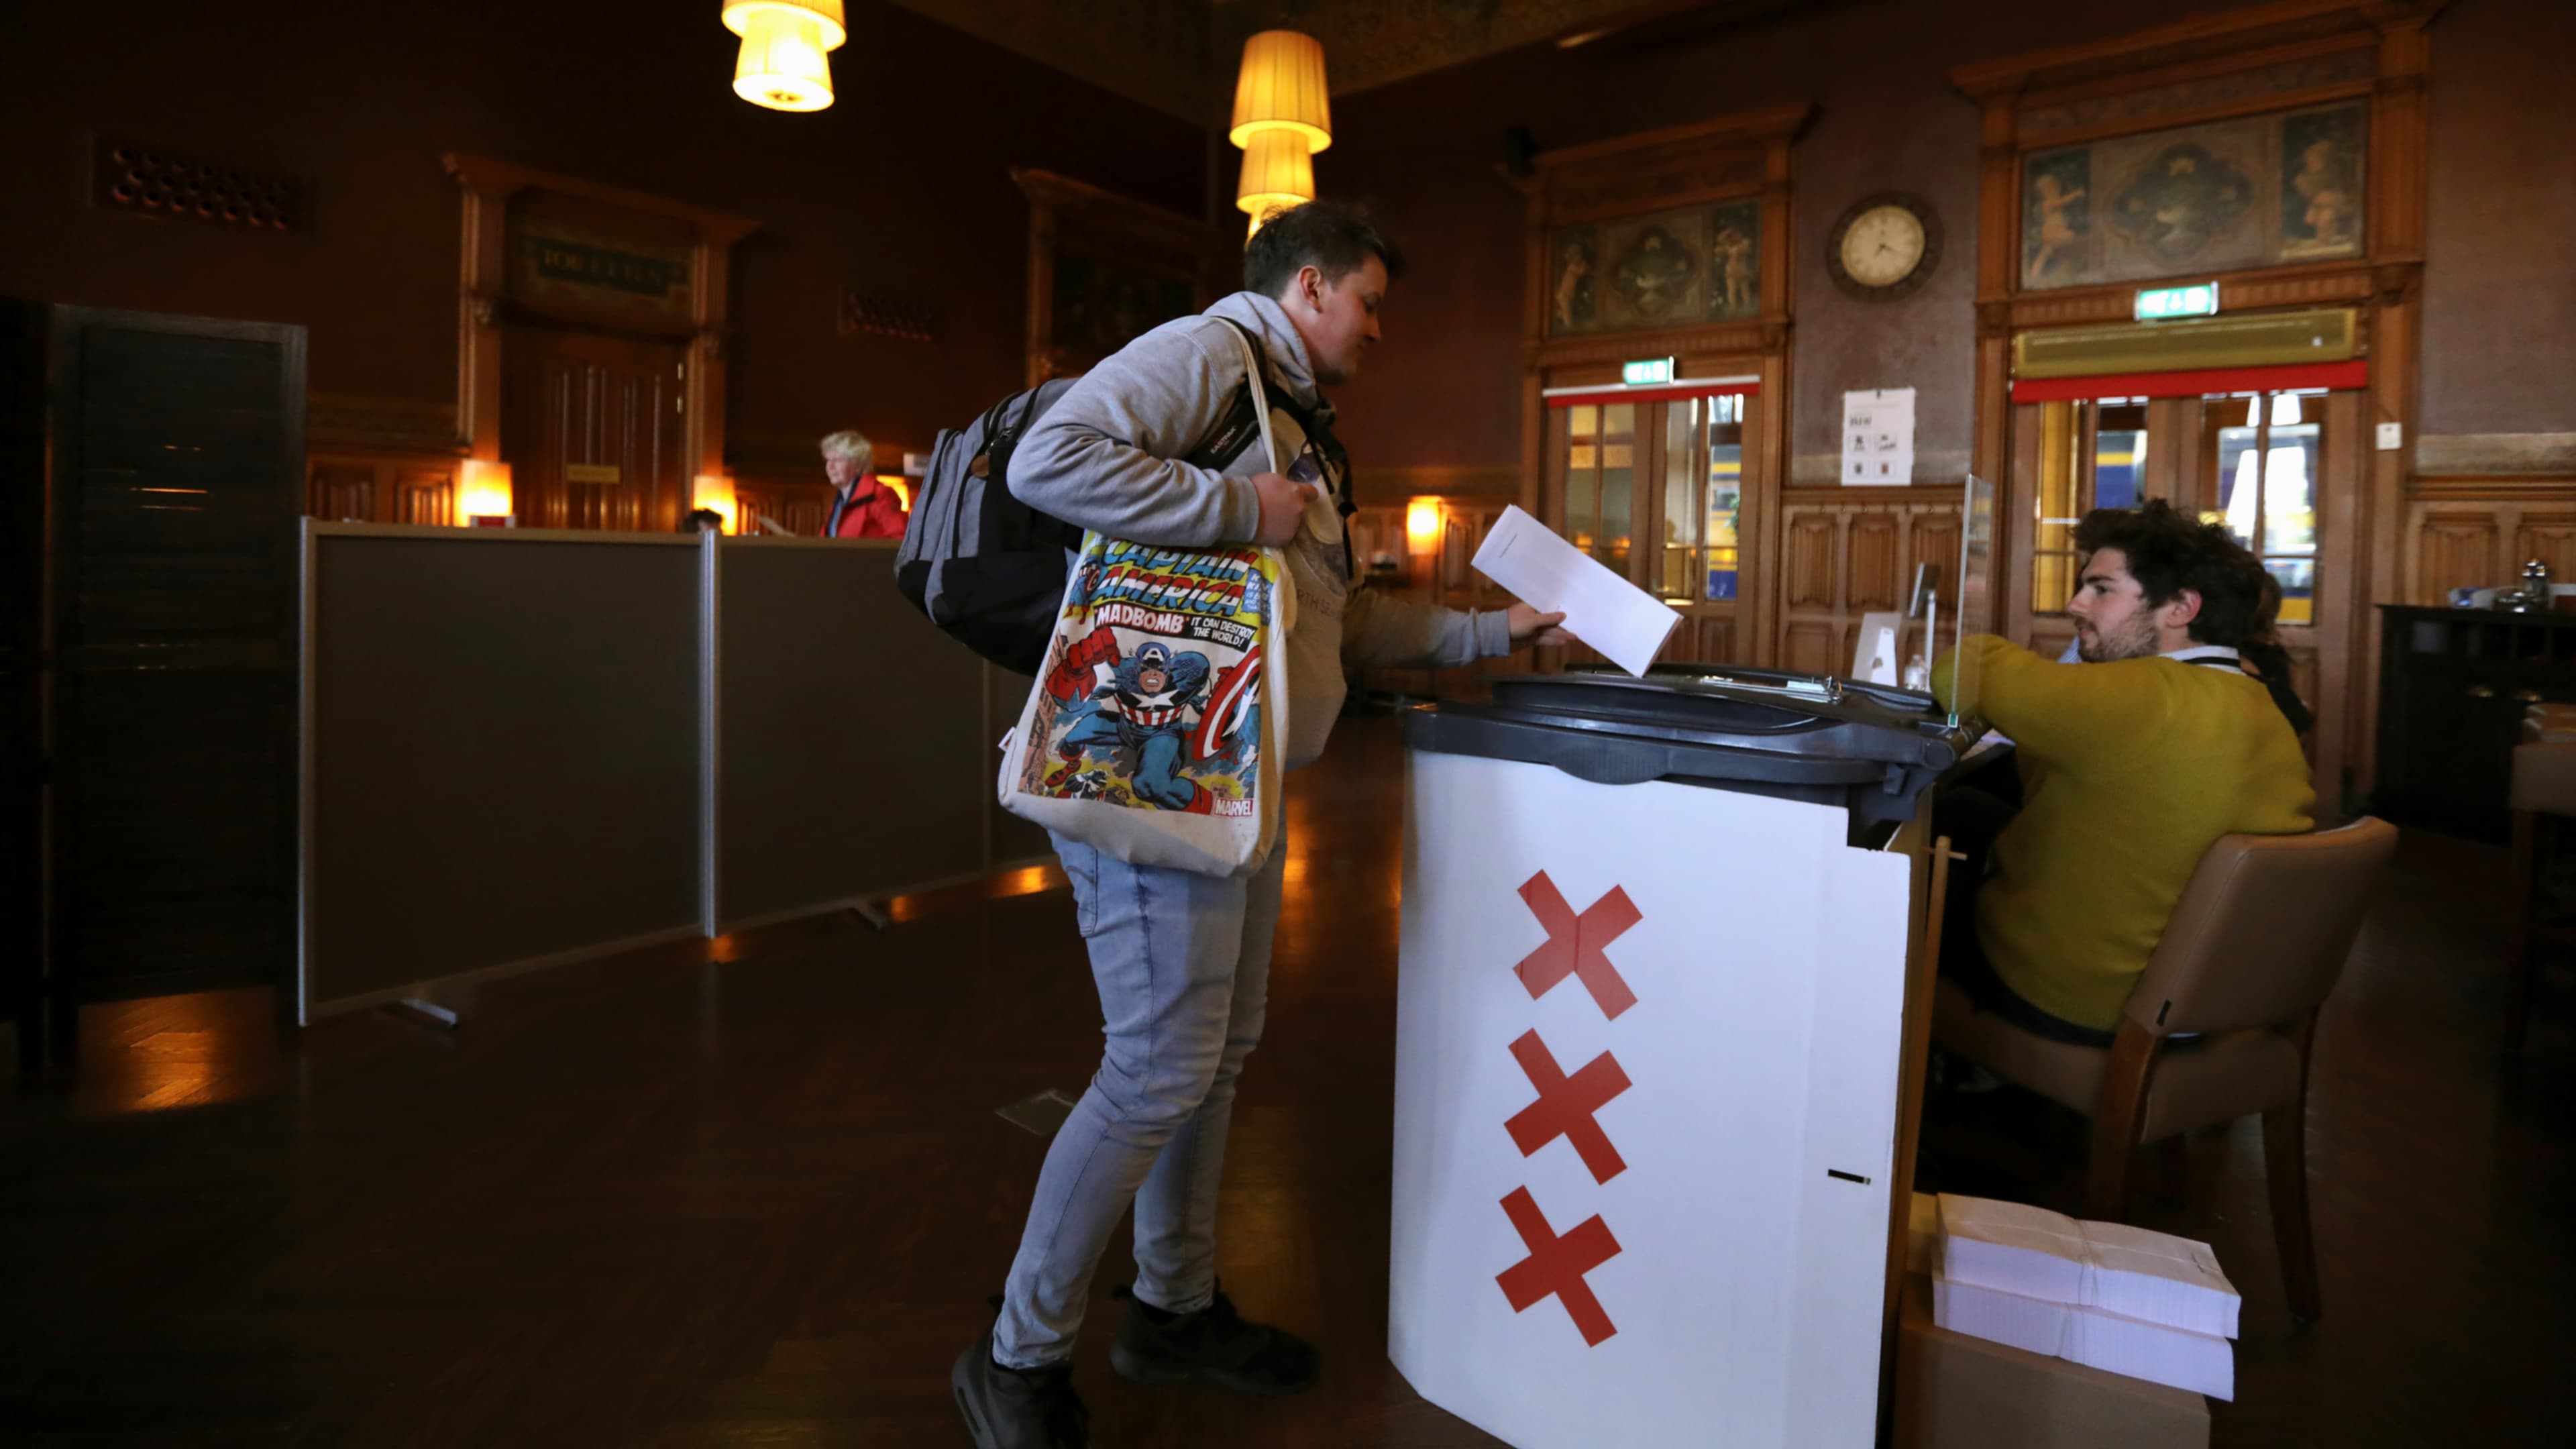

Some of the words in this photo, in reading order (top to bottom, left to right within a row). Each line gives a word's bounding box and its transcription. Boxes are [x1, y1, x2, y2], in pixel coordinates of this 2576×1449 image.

[1101, 537, 1259, 582] CAPTAIN
[1089, 566, 1246, 616] AMERICA
[1190, 616, 1201, 625] IT
[1202, 618, 1220, 629] CAN
[1219, 621, 1256, 639] DESTROY
[1193, 627, 1210, 637] THE
[1212, 629, 1245, 647] WORLD!
[1143, 648, 1165, 662] A
[1215, 799, 1252, 816] MARVEL
